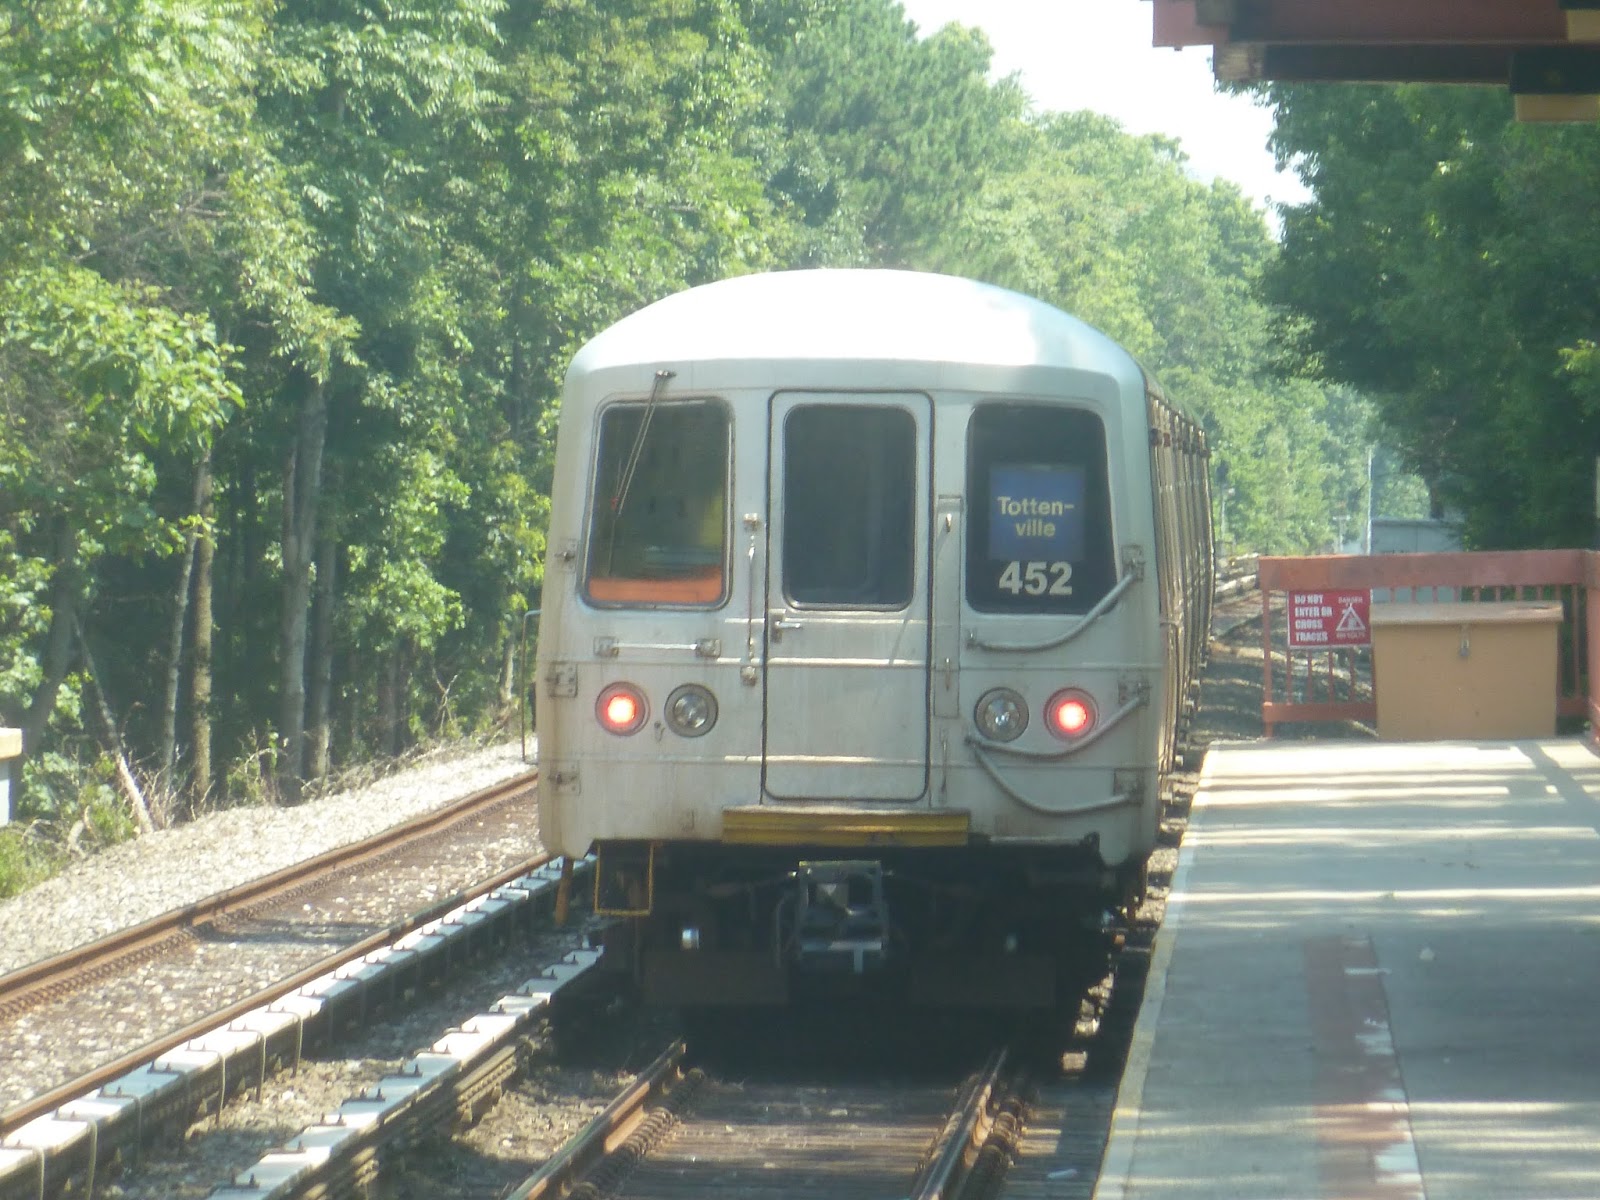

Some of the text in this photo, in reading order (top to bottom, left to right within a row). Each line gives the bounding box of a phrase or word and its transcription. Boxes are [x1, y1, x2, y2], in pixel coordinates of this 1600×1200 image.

[997, 496, 1075, 516] Totten-
[1015, 519, 1056, 537] ville
[998, 561, 1073, 595] 452
[1295, 594, 1324, 604] DO NOT
[1338, 596, 1363, 604] DANGER
[1295, 607, 1320, 617] ENTER
[1295, 619, 1323, 630] CROSS
[1295, 631, 1328, 642] TRACKS
